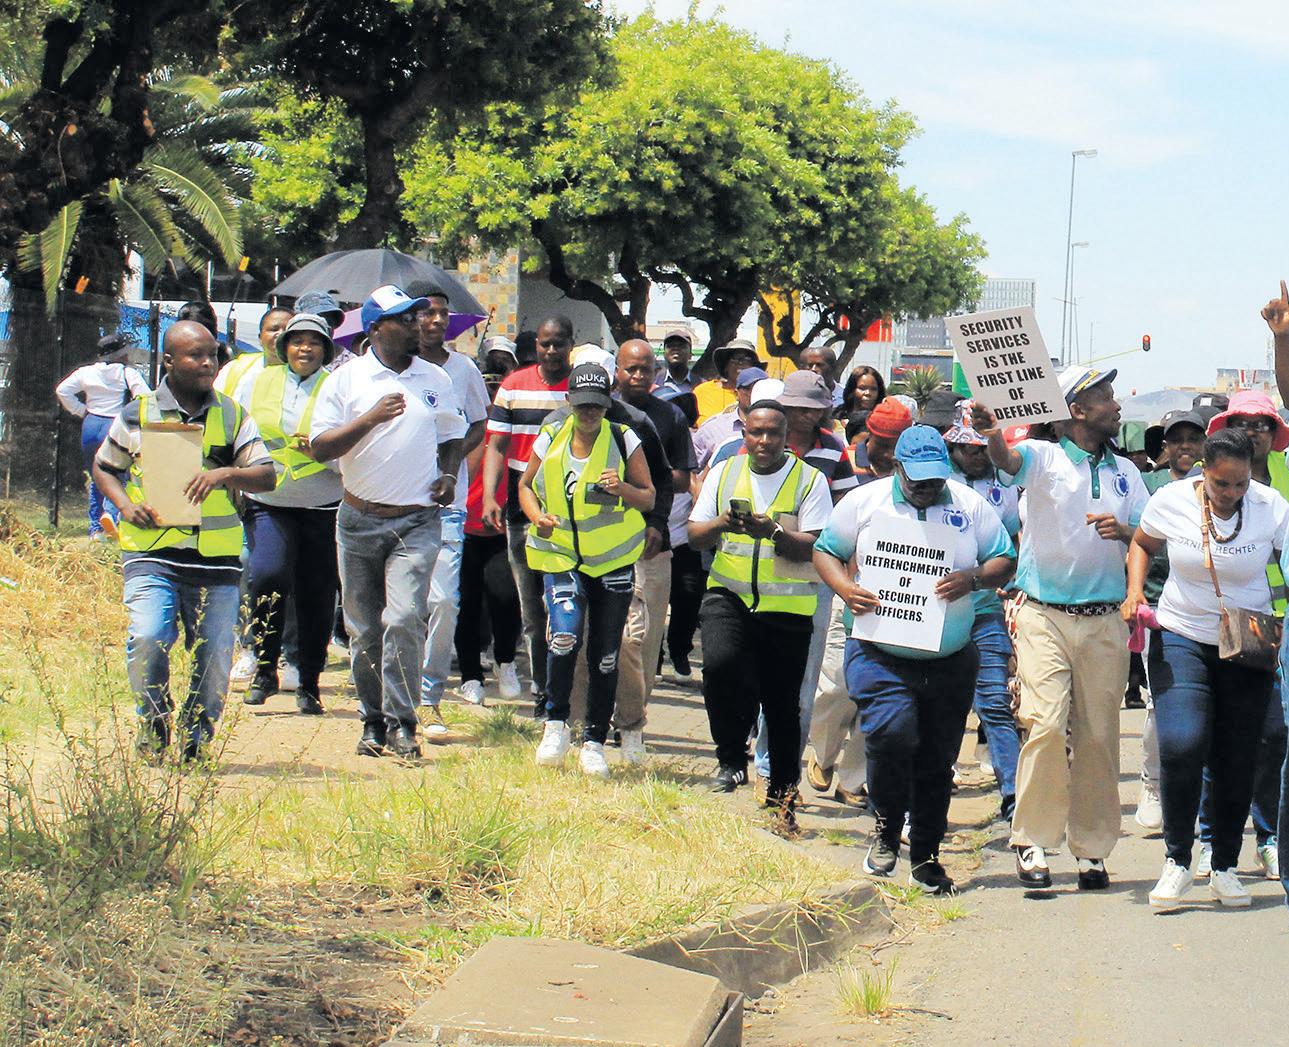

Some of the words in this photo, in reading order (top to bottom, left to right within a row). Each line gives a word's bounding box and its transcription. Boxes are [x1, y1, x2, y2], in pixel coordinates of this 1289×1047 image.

[959, 316, 1024, 337] SECURITY
[966, 333, 1030, 354] SERVICES
[983, 355, 999, 369] IS
[1000, 352, 1026, 366] THE
[575, 373, 606, 384] INUKA
[976, 371, 1014, 388] FIRST
[1016, 366, 1045, 382] LINE
[1008, 387, 1025, 401] OF
[993, 401, 1053, 421] DEFENSE.
[876, 540, 945, 561] MORATORIUM
[1214, 543, 1257, 555] HECHTER
[865, 555, 951, 577] RETRENCHMENTS
[899, 576, 912, 588] OF
[878, 589, 928, 607] SECURITY
[875, 605, 925, 623] OFFICERS.
